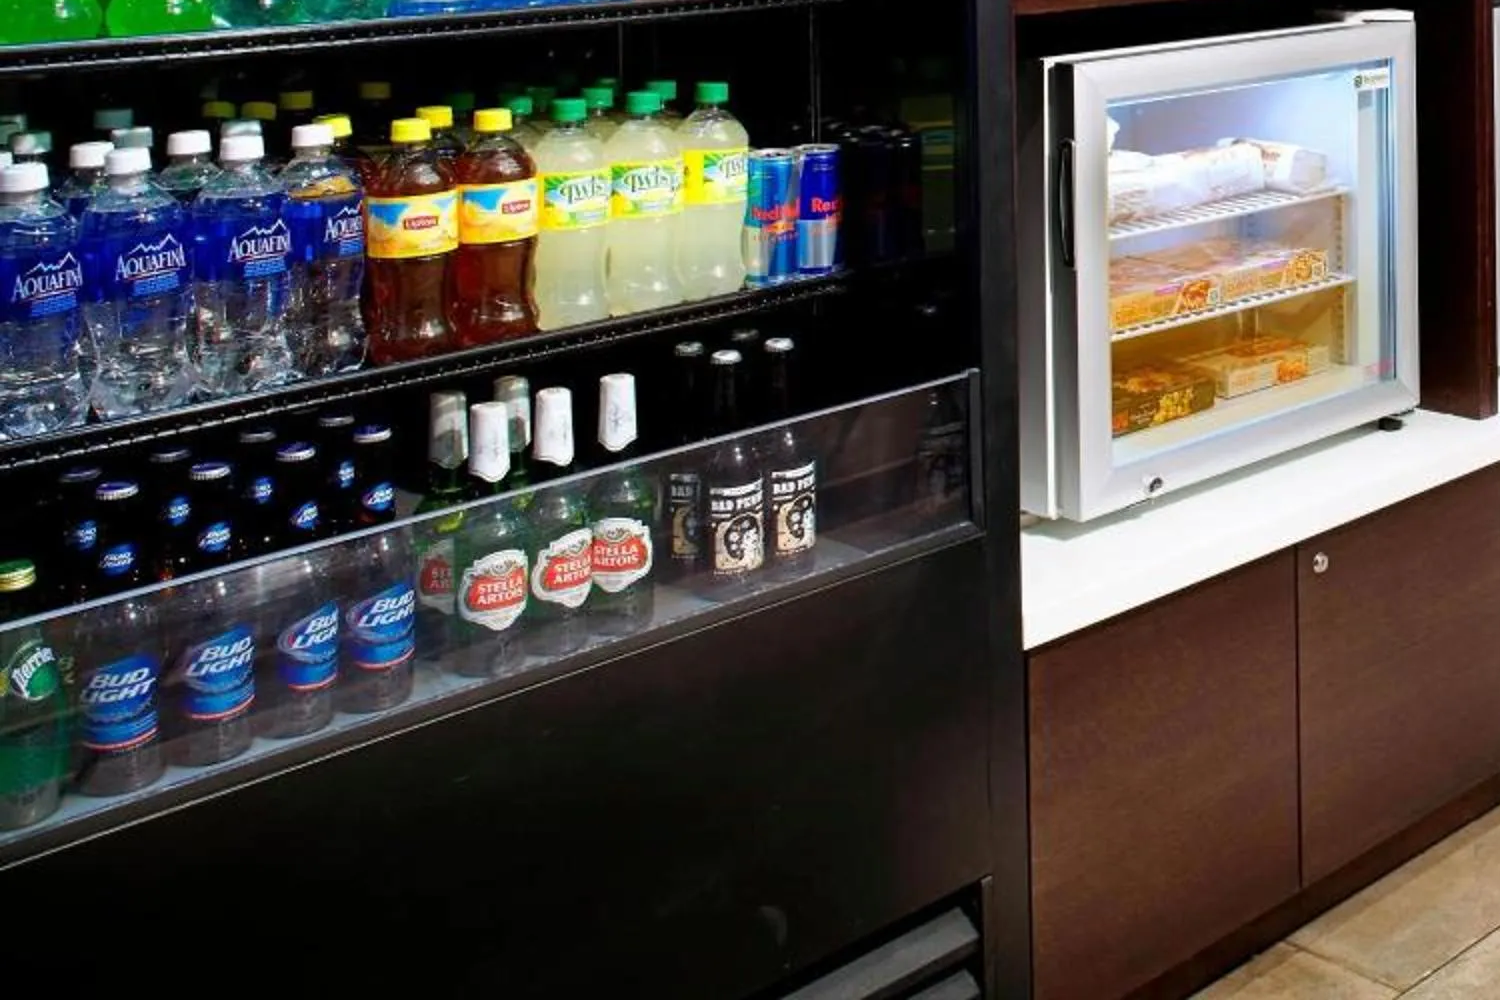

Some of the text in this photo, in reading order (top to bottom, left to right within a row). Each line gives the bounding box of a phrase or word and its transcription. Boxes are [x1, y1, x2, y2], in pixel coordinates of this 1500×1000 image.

[593, 544, 639, 557] STELLA
[593, 554, 640, 568] ARTOIS
[477, 574, 524, 594] STELLA
[370, 589, 415, 614] BUD
[186, 645, 255, 677] LIGHT
[199, 636, 252, 662] BUD
[80, 677, 157, 704] LIGHT
[90, 667, 150, 690] BUD
